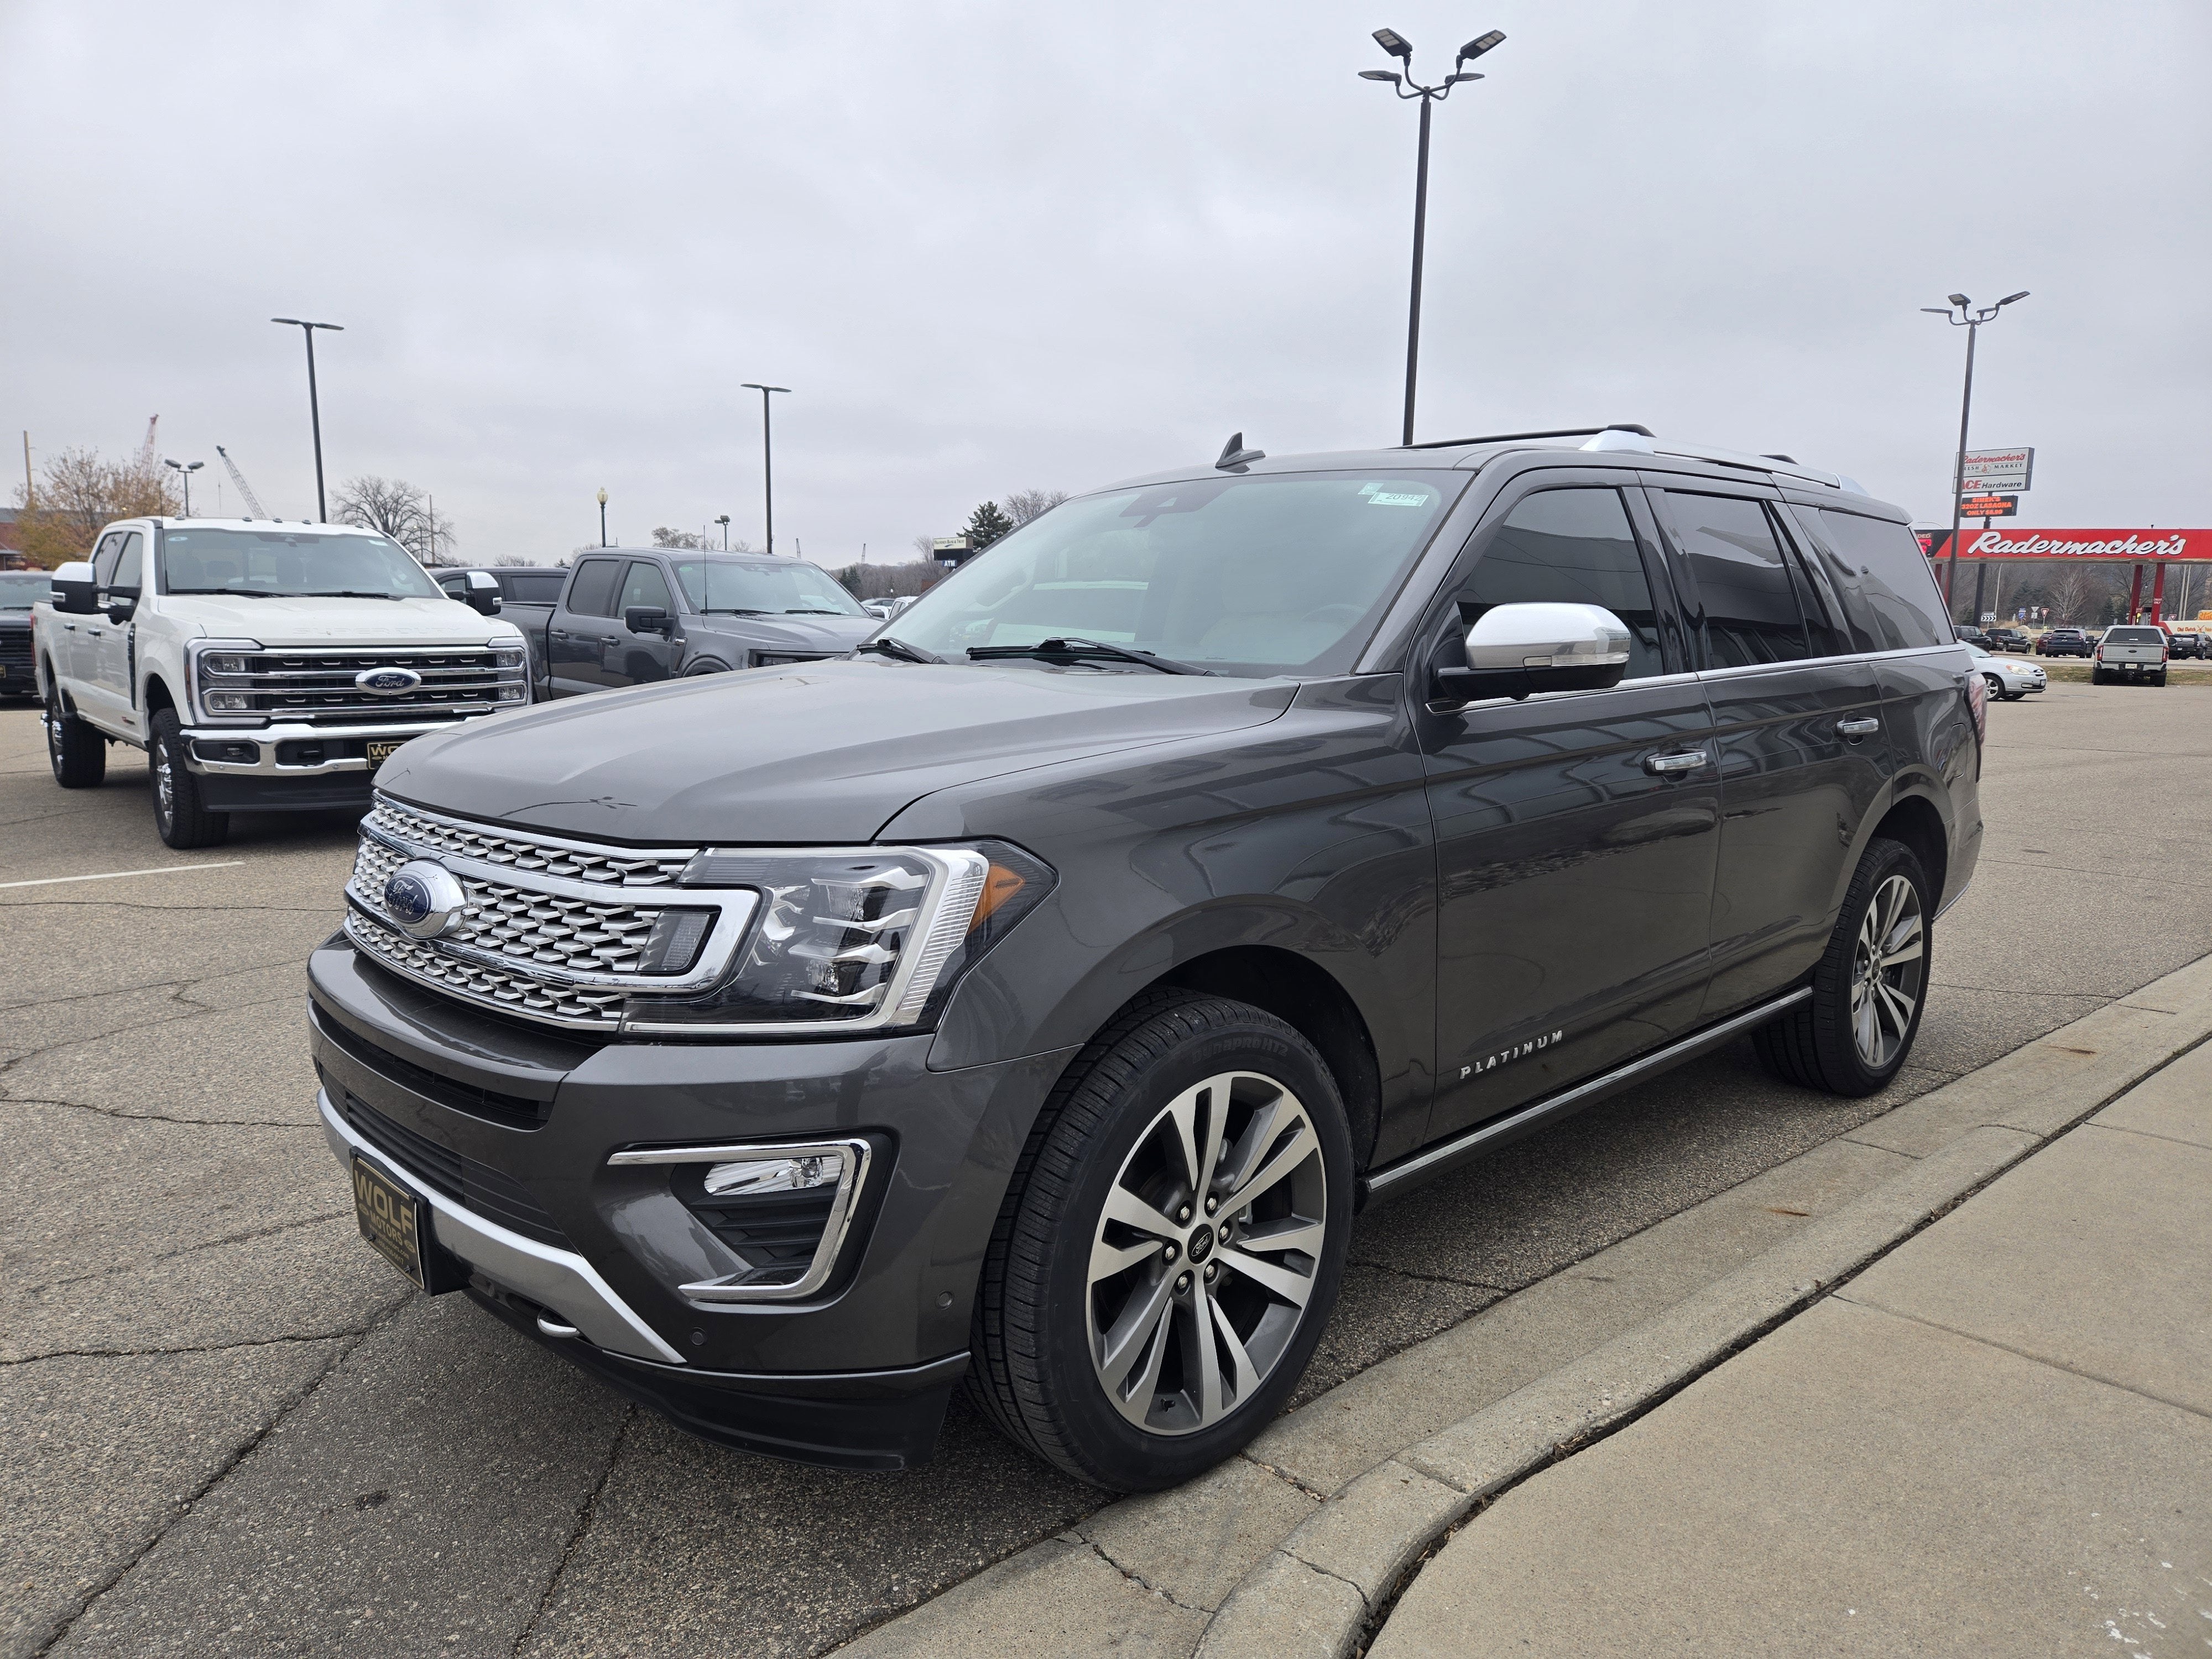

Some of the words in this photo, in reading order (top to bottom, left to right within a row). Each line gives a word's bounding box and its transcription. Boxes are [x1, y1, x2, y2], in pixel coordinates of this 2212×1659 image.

[1968, 531, 2186, 555] Radermacher's
[375, 675, 404, 687] Ford
[388, 880, 418, 915] Ford
[1460, 1030, 1562, 1079] PLATINUM
[354, 1170, 413, 1234] WOLF
[370, 1209, 403, 1246] MOTORS
